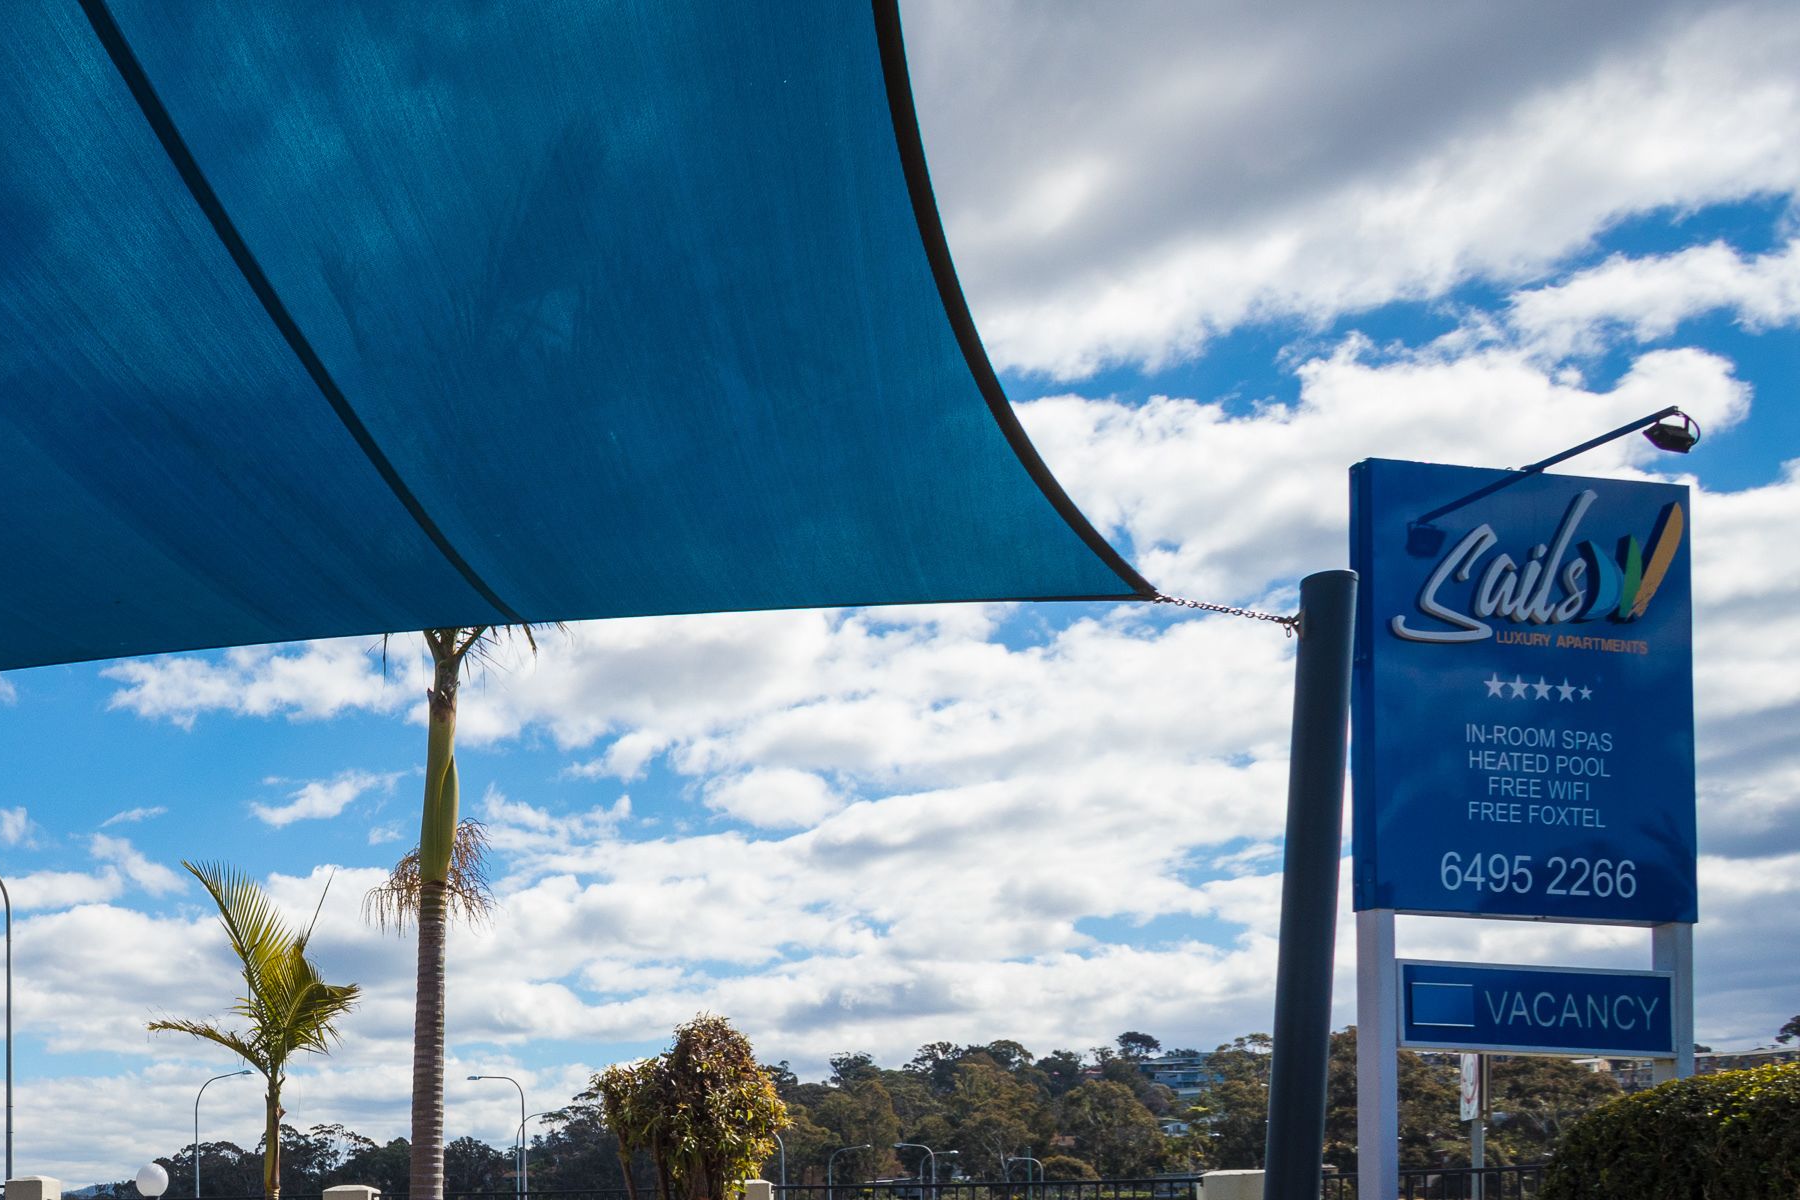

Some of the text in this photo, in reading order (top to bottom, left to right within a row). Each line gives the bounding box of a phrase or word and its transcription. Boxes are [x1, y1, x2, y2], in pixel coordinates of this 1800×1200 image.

[1391, 489, 1598, 643] Sails
[1496, 630, 1648, 655] LUXURY APARTMENTS
[1466, 723, 1613, 752] IN-ROOM SPAS
[1469, 750, 1611, 778] HEATED POOL
[1488, 776, 1590, 801] FREE WIFI
[1468, 801, 1606, 828] FREE FOXTEL
[1440, 851, 1637, 899] 6495 2266
[1484, 990, 1659, 1031] VACANCY
